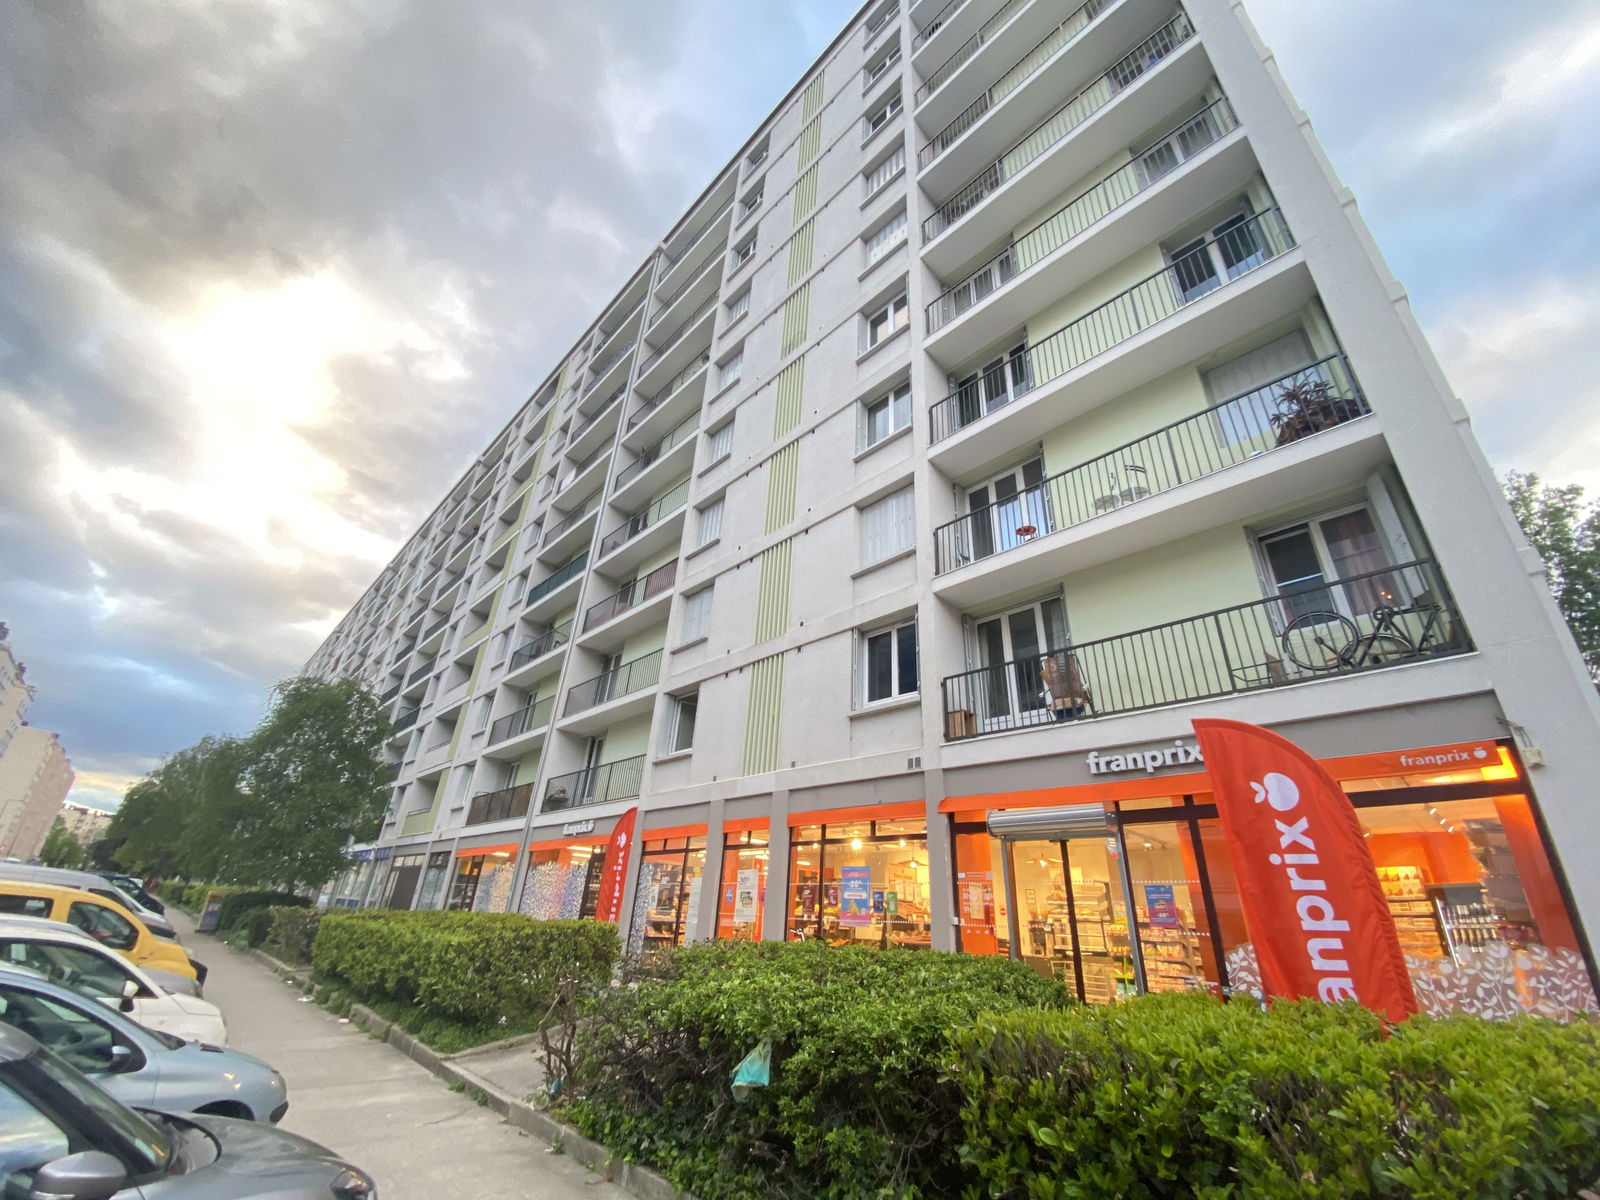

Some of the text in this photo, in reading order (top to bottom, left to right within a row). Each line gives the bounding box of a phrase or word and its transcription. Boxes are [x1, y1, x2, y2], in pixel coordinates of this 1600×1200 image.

[1086, 740, 1204, 774] franprix
[1400, 749, 1471, 767] franprix
[1268, 816, 1360, 1006] anprix
